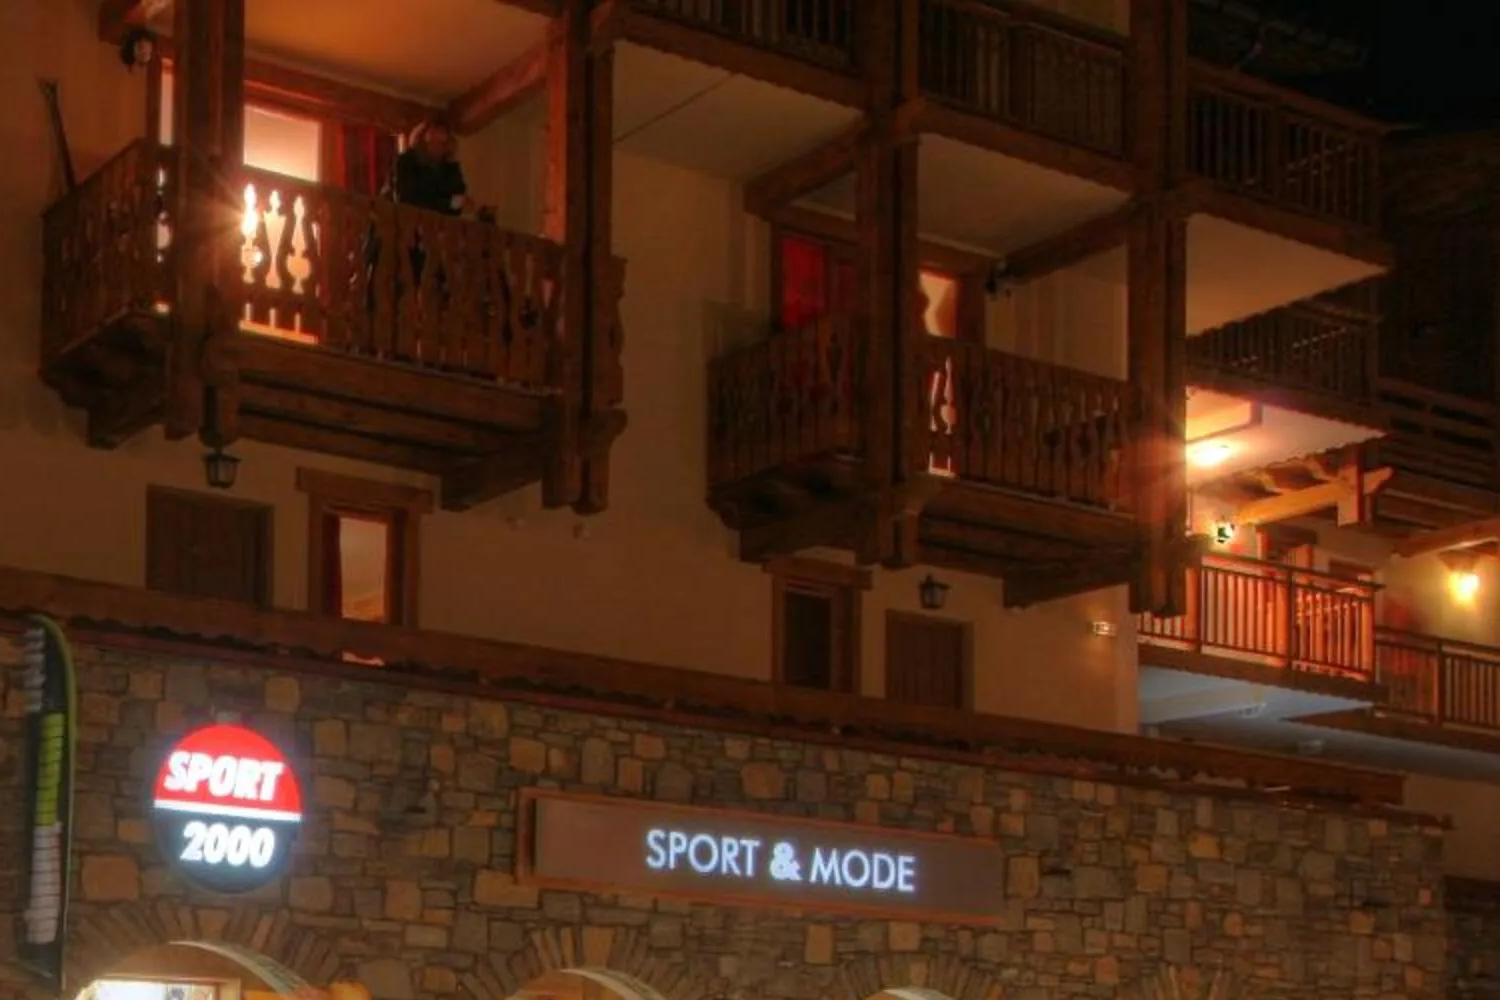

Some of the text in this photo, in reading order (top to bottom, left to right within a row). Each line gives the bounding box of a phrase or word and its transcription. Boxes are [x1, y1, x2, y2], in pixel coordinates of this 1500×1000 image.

[163, 750, 285, 802] SPORT
[178, 820, 276, 868] 2000
[645, 828, 918, 893] SPORT & MODE
